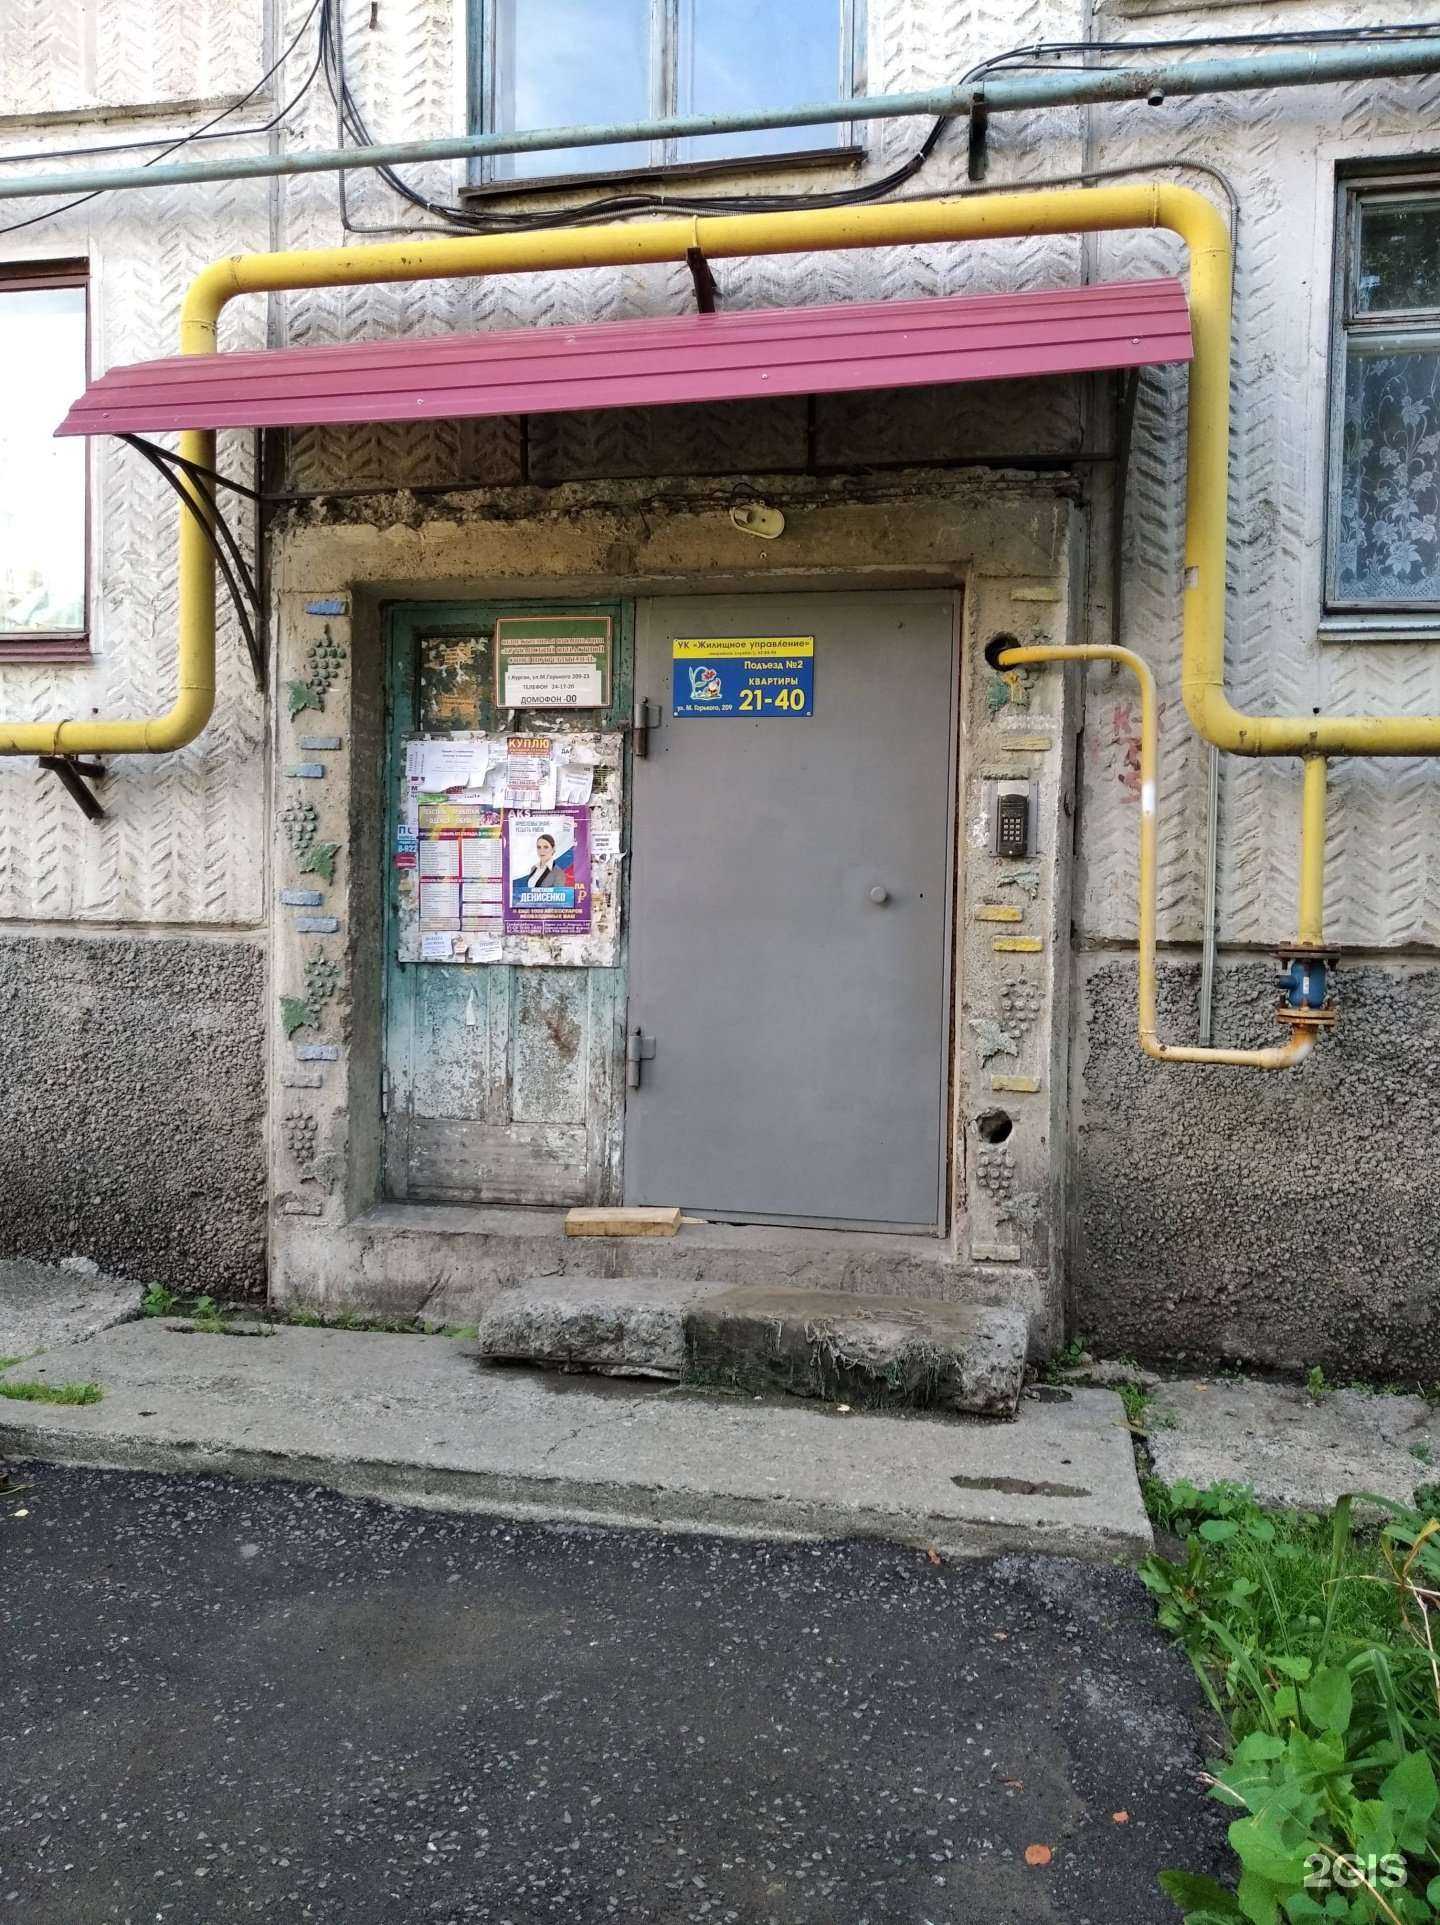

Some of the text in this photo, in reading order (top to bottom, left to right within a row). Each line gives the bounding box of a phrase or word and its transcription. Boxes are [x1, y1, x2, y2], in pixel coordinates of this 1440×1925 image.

[677, 640, 810, 650] УК «Жилищное управление»
[744, 660, 804, 670] Подъезд №2
[748, 677, 798, 686] КВАРТИРЫ
[521, 696, 562, 704] ДОМОФОН
[738, 688, 805, 711] 21-40
[508, 738, 549, 748] КУПЛЮ
[508, 809, 531, 818] AKS
[520, 892, 566, 902] ДЕНИСЕНКО
